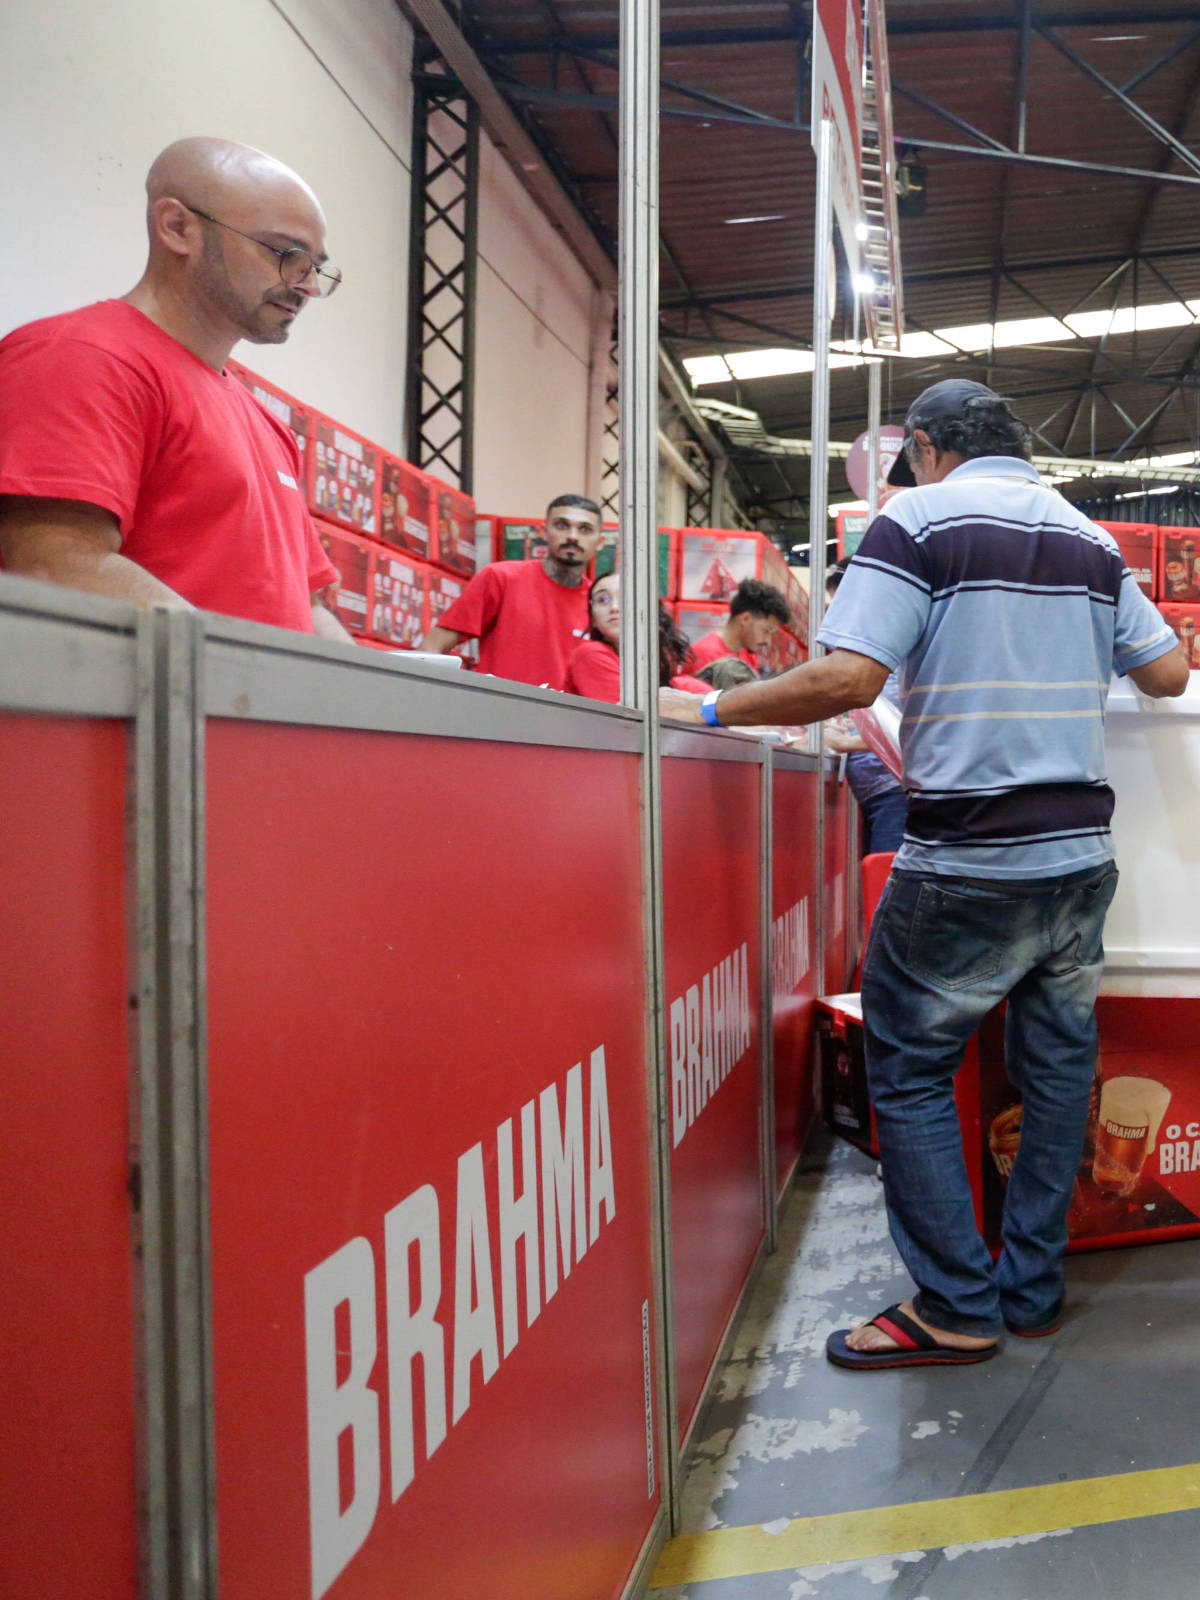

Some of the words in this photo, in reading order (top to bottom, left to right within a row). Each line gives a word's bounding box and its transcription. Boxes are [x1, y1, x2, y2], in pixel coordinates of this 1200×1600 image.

[670, 941, 751, 1149] BRAHMA
[1106, 1120, 1146, 1139] BRAHMA
[1166, 1124, 1182, 1139] O
[303, 1043, 616, 1599] BRAHMA
